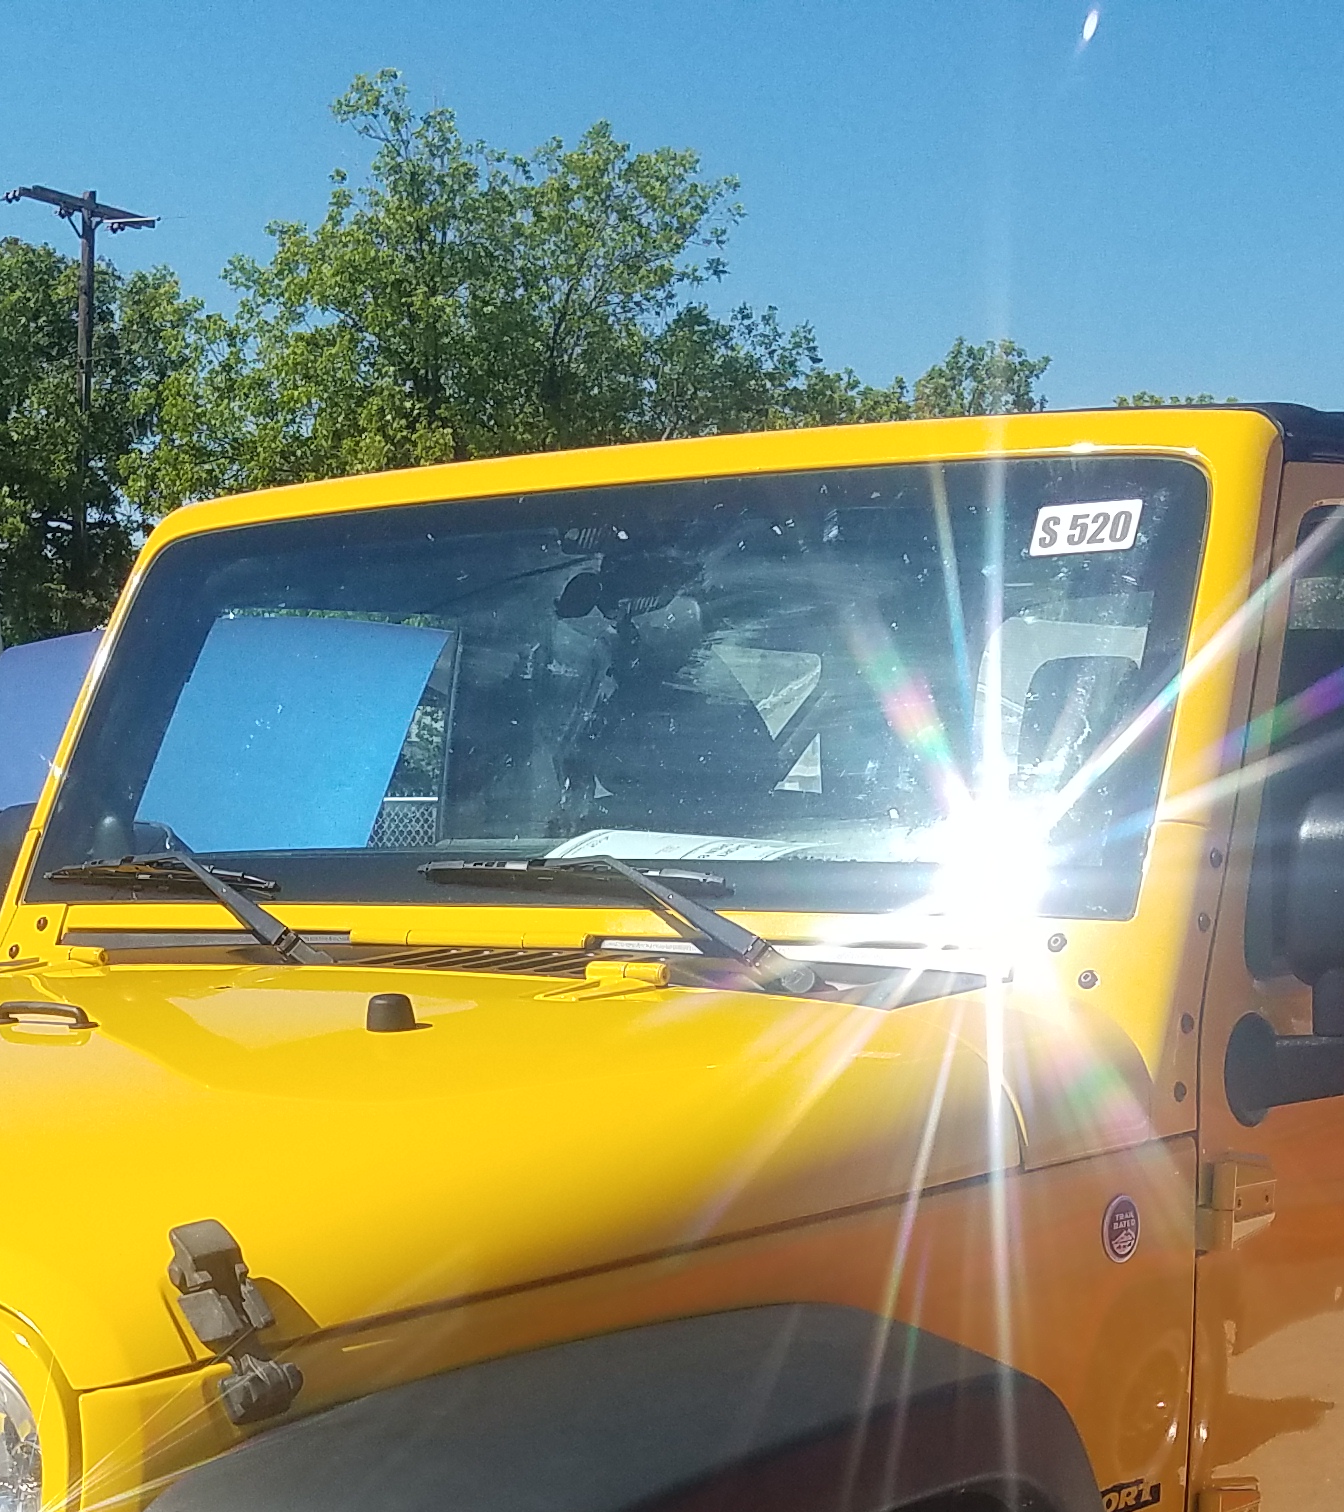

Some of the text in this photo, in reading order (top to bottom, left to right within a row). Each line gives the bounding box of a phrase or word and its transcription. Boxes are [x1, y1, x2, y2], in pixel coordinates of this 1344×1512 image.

[1038, 510, 1133, 549] S 520
[1115, 1211, 1135, 1221] TRAIL
[1113, 1219, 1136, 1230] RATED
